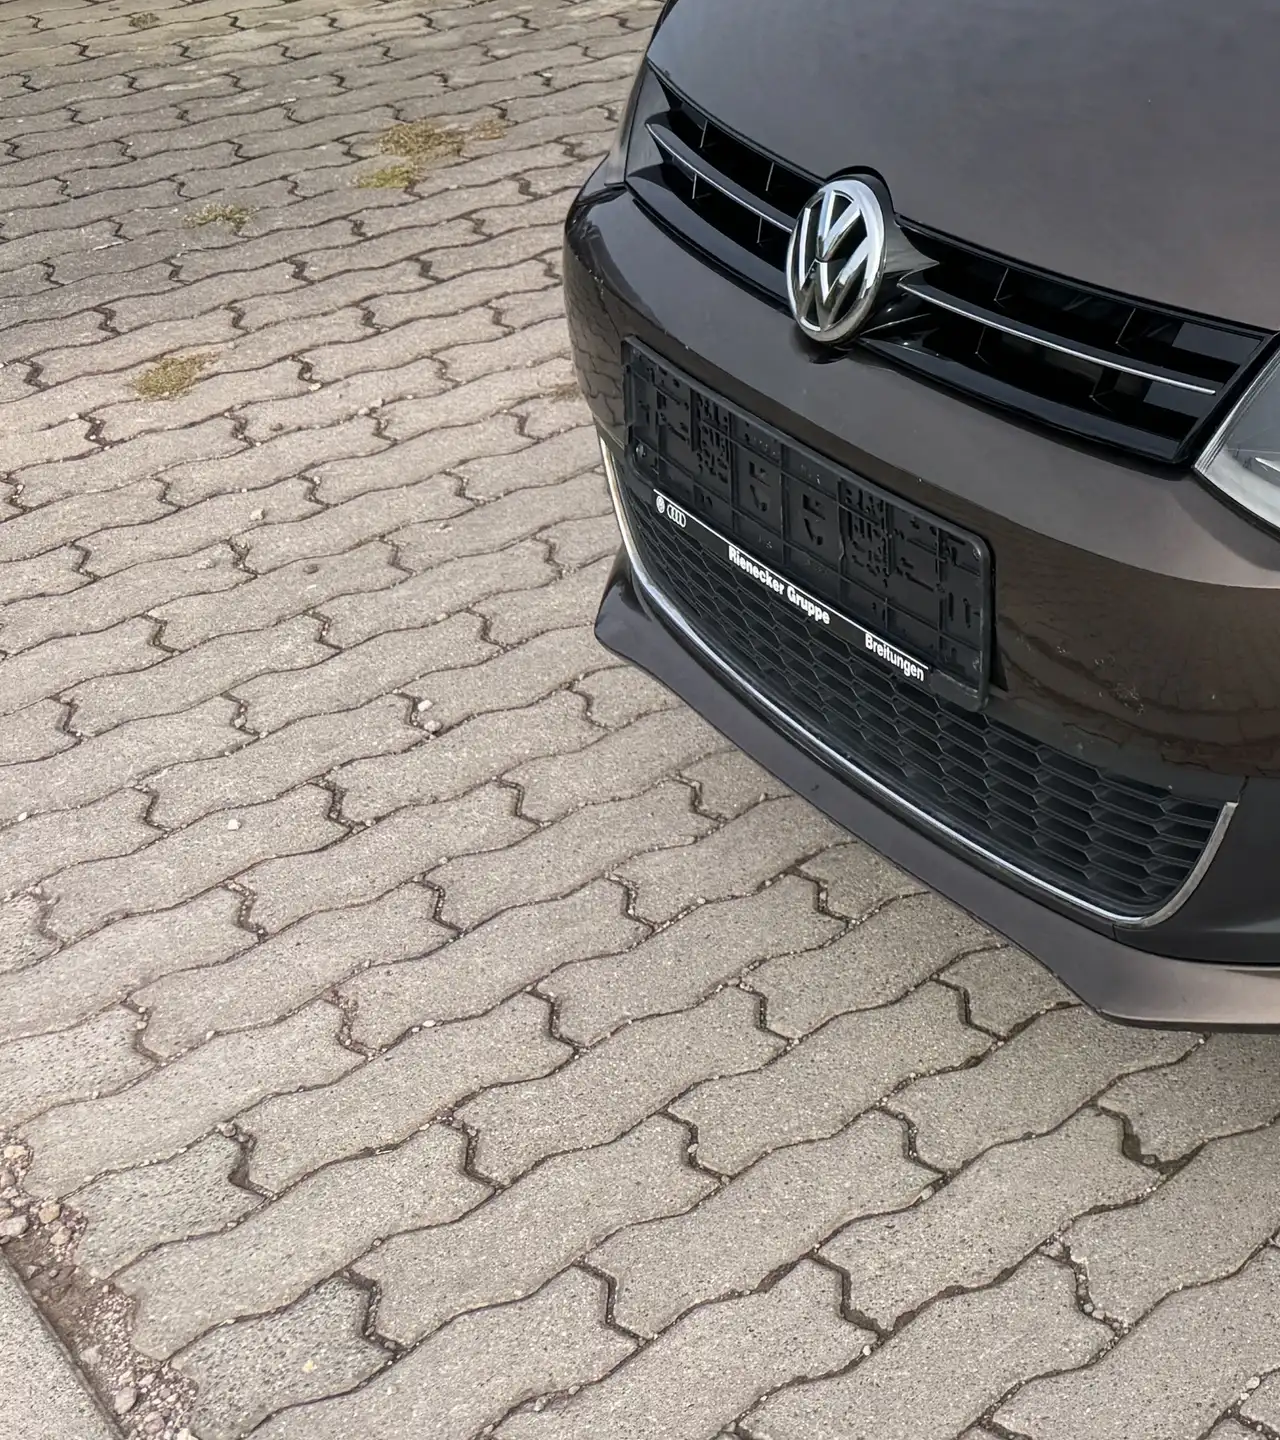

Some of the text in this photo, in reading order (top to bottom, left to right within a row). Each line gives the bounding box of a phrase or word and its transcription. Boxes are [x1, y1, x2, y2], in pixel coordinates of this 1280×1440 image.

[728, 545, 925, 682] Rienecker Gruppe Breitungen
